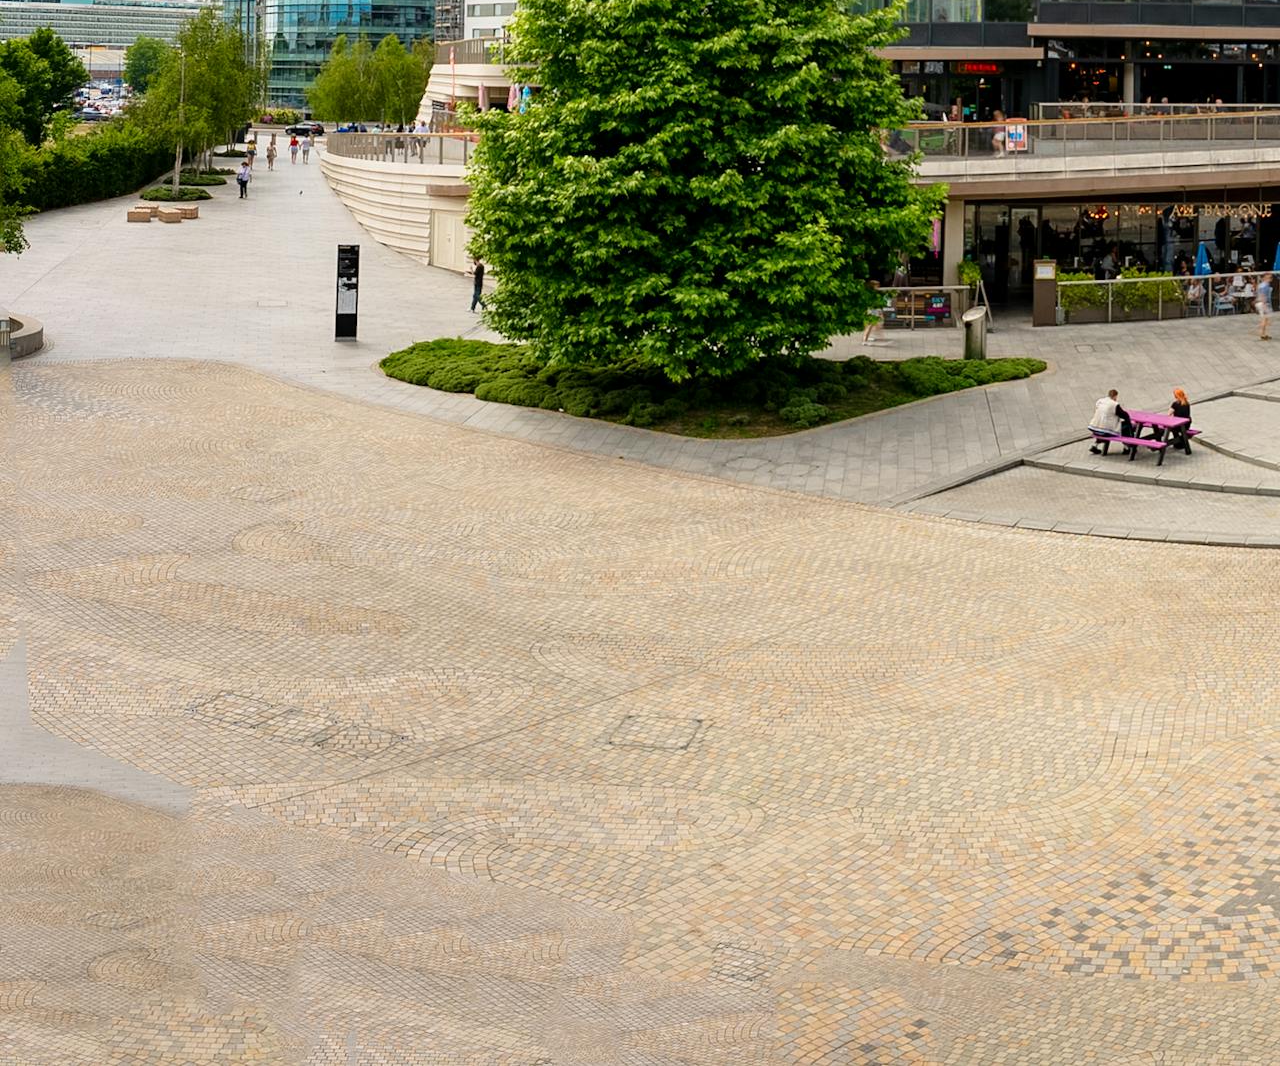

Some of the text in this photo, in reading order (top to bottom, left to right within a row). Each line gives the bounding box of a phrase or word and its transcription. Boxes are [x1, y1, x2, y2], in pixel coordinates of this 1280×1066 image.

[1170, 203, 1272, 217] ALL BAR ONE
